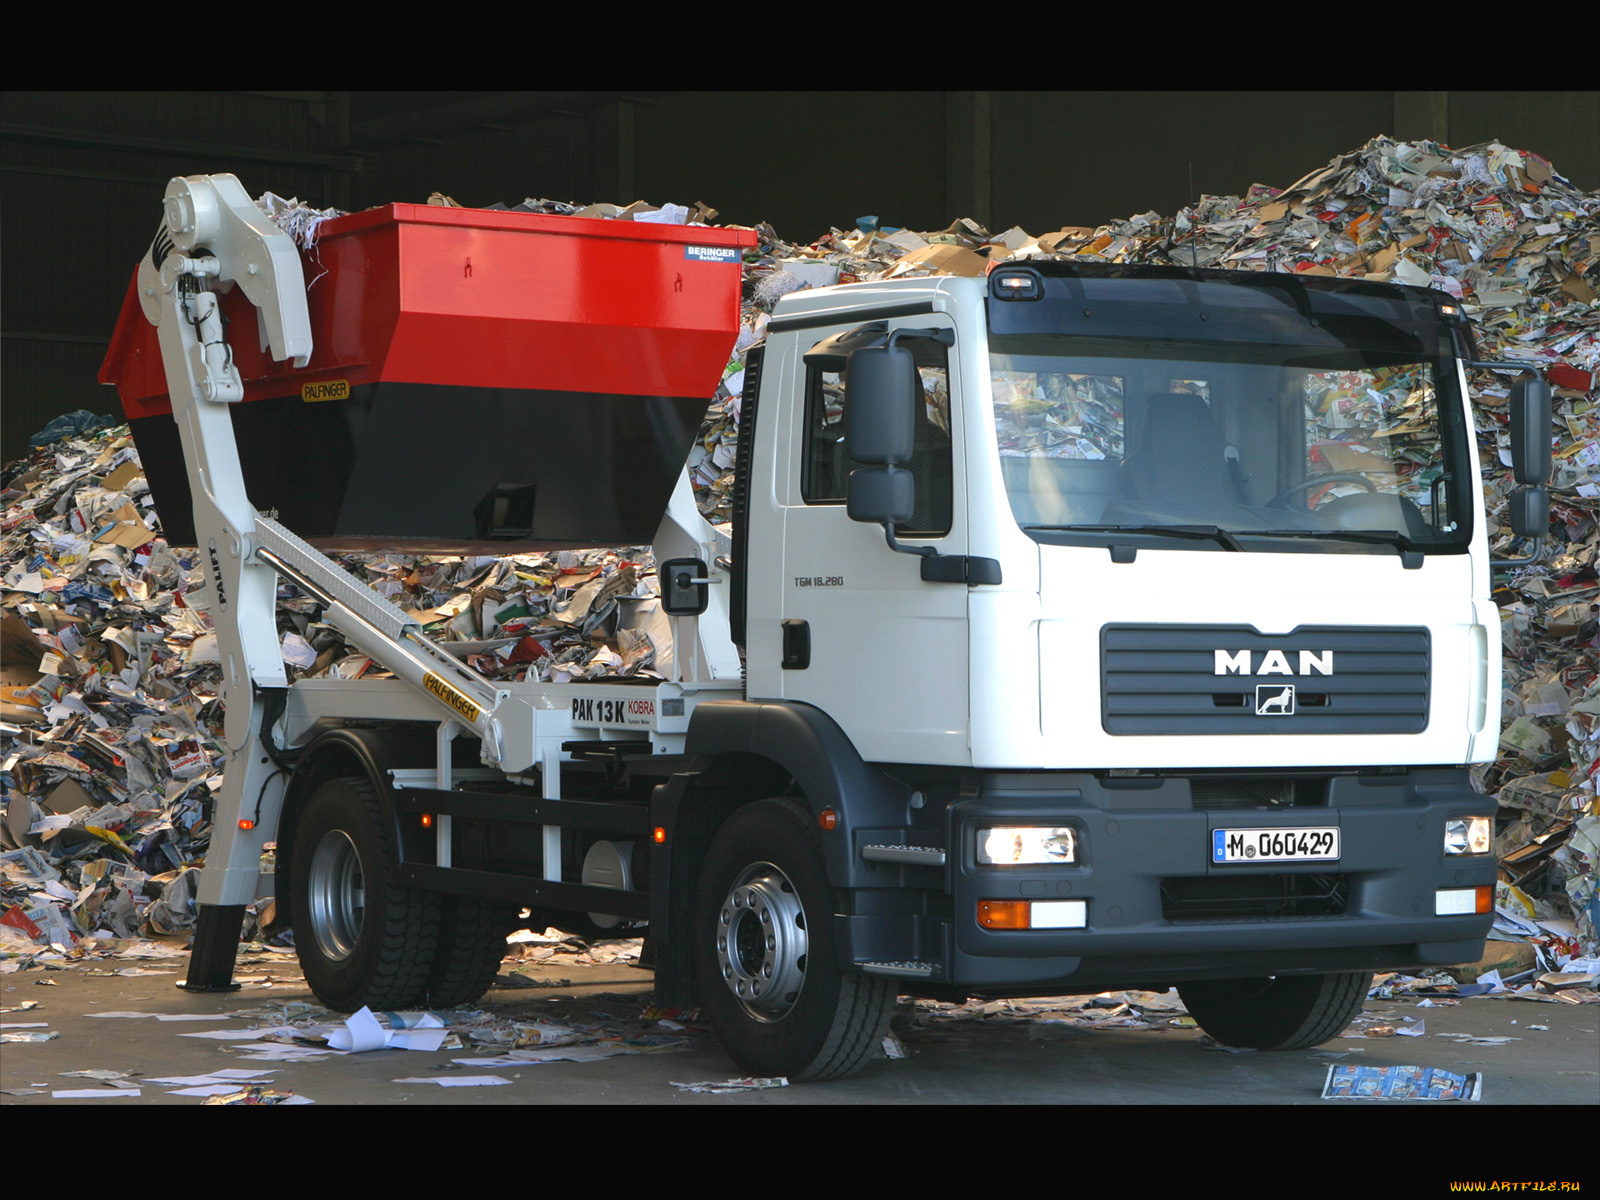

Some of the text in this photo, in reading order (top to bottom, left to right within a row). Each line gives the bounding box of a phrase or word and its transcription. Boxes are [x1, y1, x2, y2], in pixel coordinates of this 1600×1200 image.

[688, 246, 735, 257] BERINGER
[304, 382, 347, 399] PALFINGER
[209, 547, 227, 604] PALIFT
[794, 576, 844, 587] TGM 18.280
[1214, 649, 1333, 676] MAN
[425, 673, 477, 719] PALFINGER
[572, 698, 594, 721] PAK
[596, 700, 625, 724] 13K
[628, 700, 655, 715] KOBRA
[1230, 832, 1334, 857] M 060429
